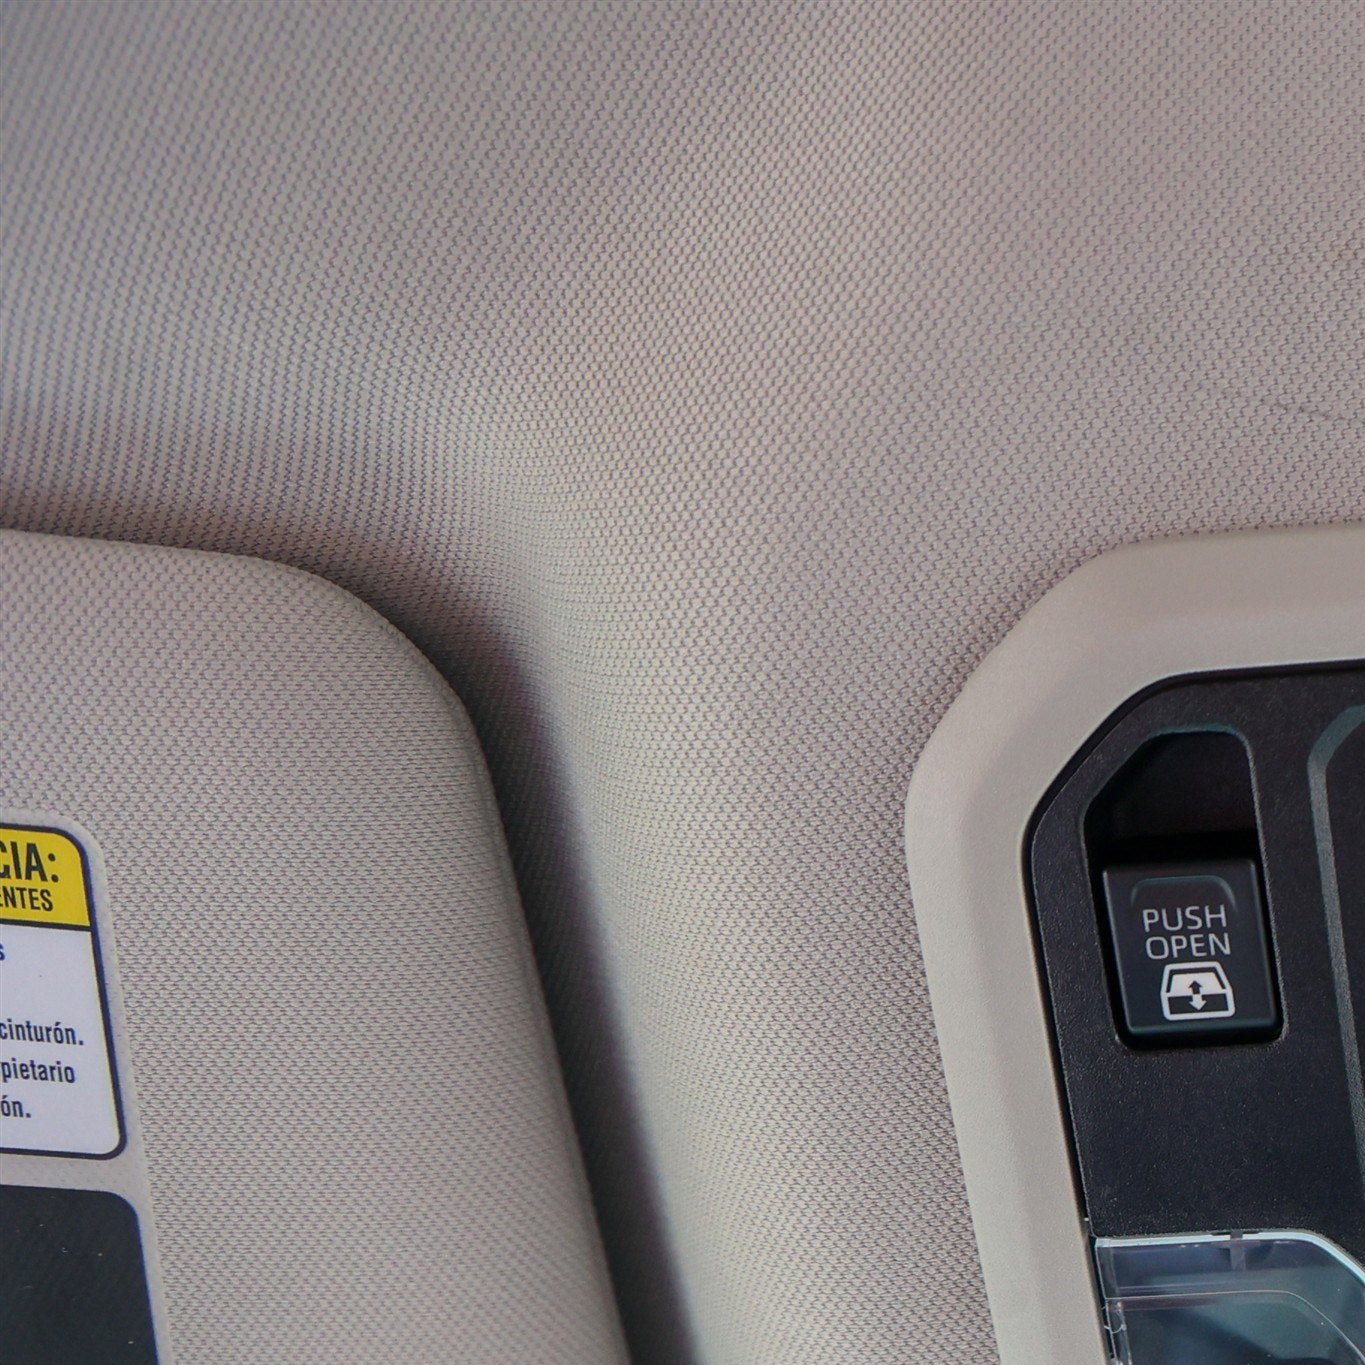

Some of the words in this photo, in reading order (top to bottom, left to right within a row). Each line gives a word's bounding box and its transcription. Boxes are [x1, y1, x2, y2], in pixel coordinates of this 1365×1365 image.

[0, 885, 54, 912] NTES
[1142, 904, 1227, 933] PUSH
[1145, 932, 1231, 960] OPEN
[0, 1018, 84, 1046] cinturón.
